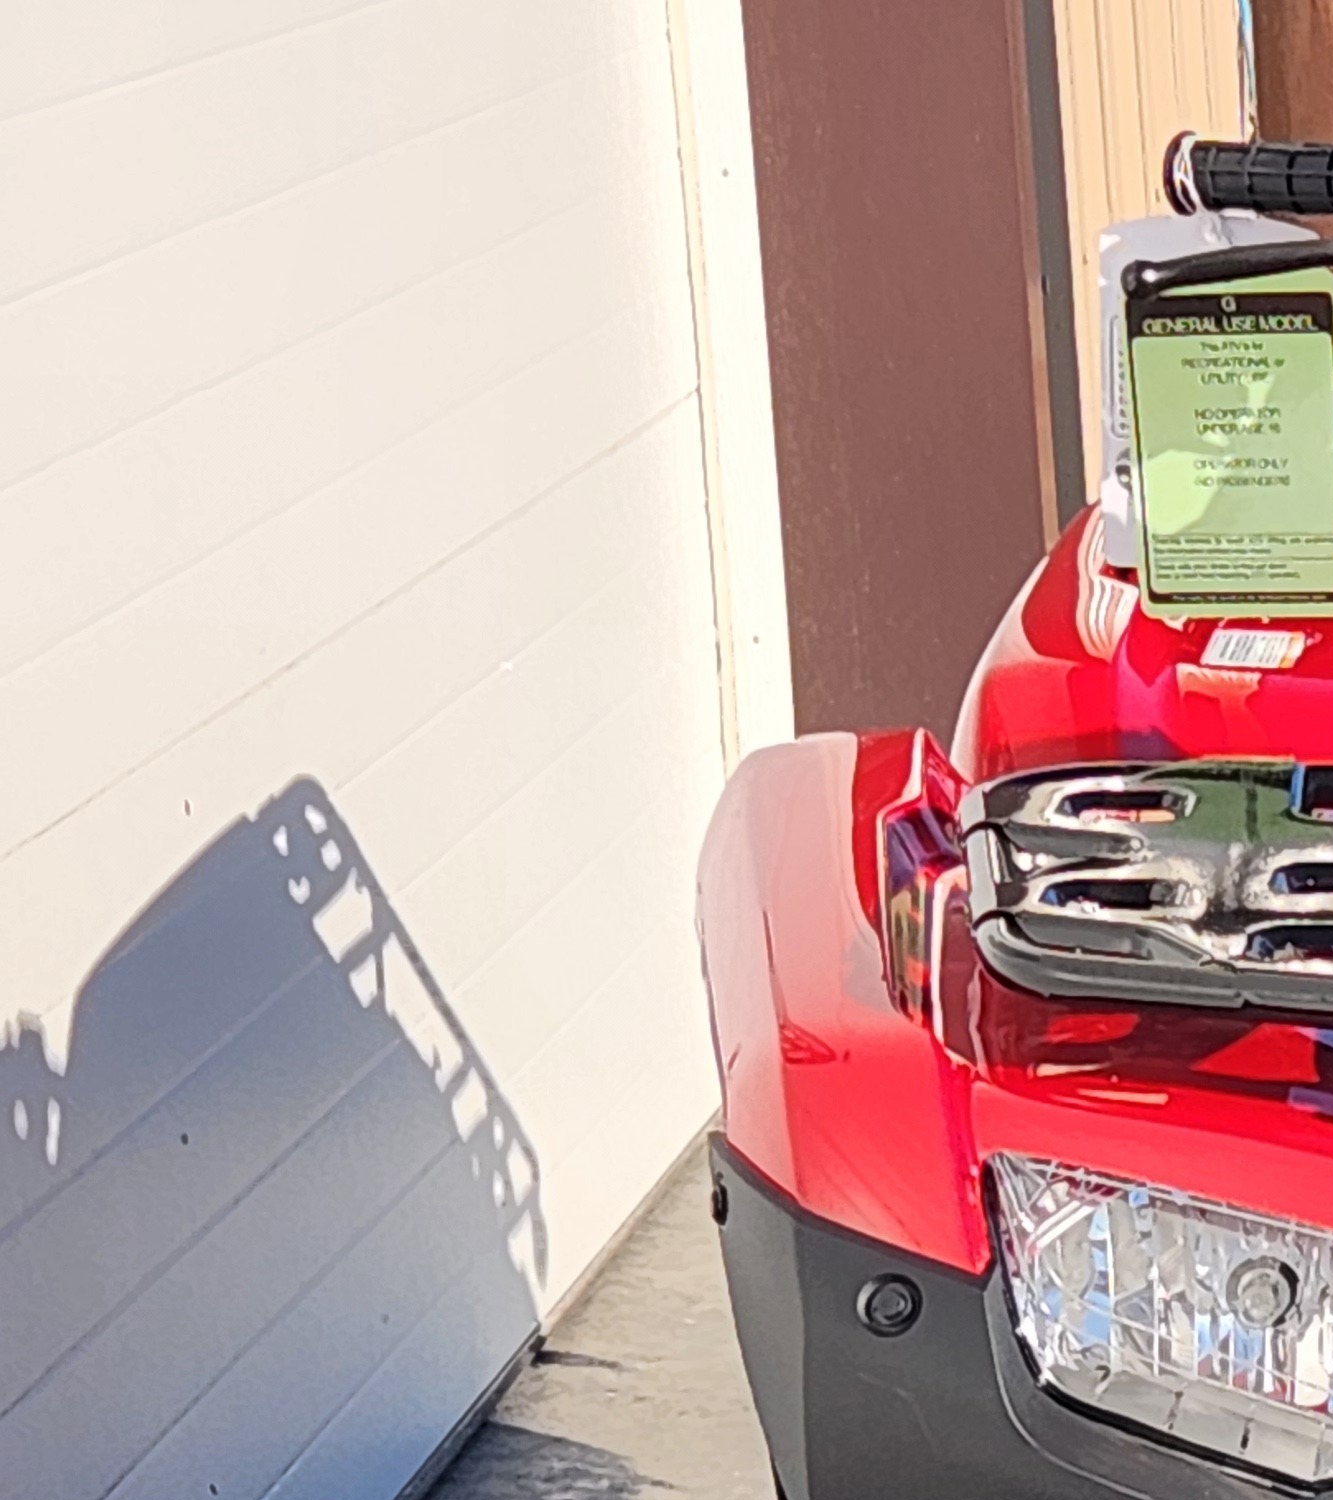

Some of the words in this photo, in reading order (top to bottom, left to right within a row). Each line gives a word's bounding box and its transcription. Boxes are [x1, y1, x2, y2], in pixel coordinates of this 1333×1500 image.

[1221, 296, 1236, 313] G
[1142, 315, 1220, 334] GENERAL
[1222, 314, 1256, 332] USE
[1258, 313, 1319, 332] MODEL
